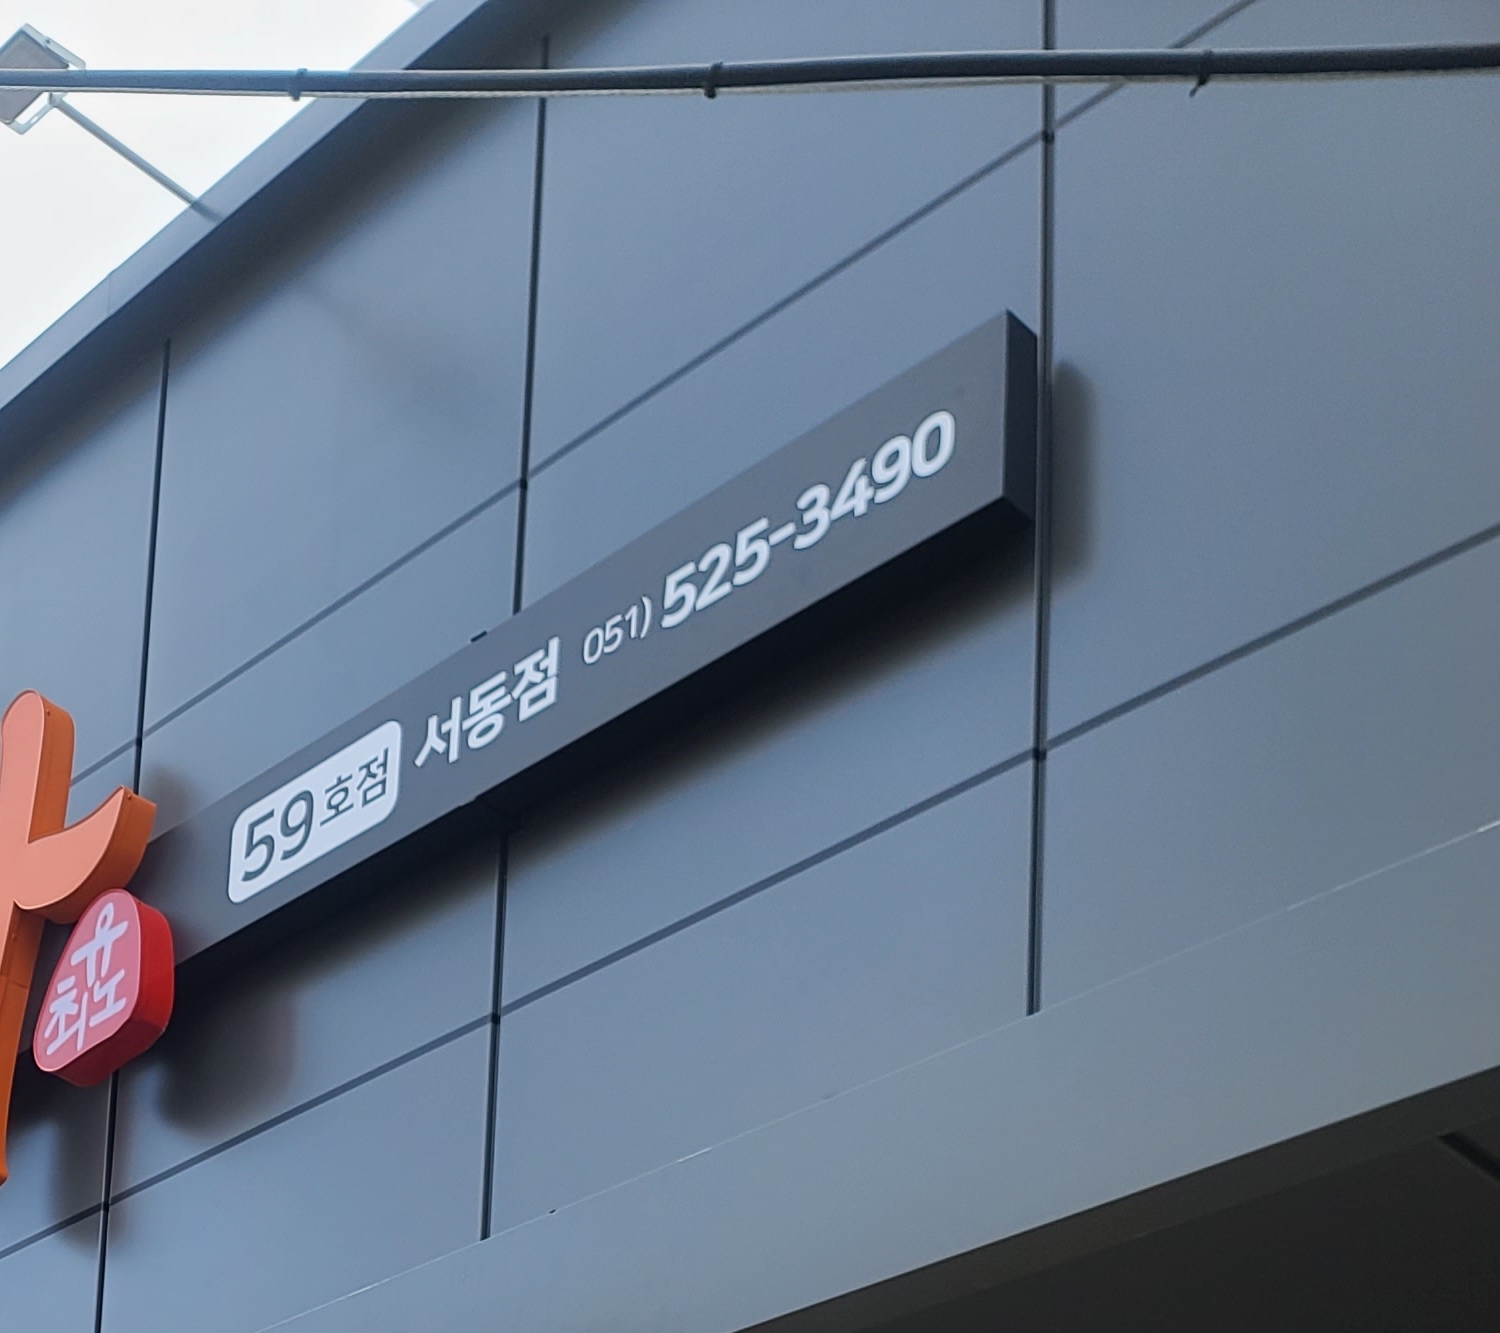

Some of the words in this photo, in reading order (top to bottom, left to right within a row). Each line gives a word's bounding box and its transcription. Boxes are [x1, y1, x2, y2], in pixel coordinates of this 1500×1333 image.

[240, 744, 391, 884] 59호점
[414, 637, 560, 770] 서동점
[583, 595, 653, 666] 051)
[661, 409, 957, 629] 525-3490
